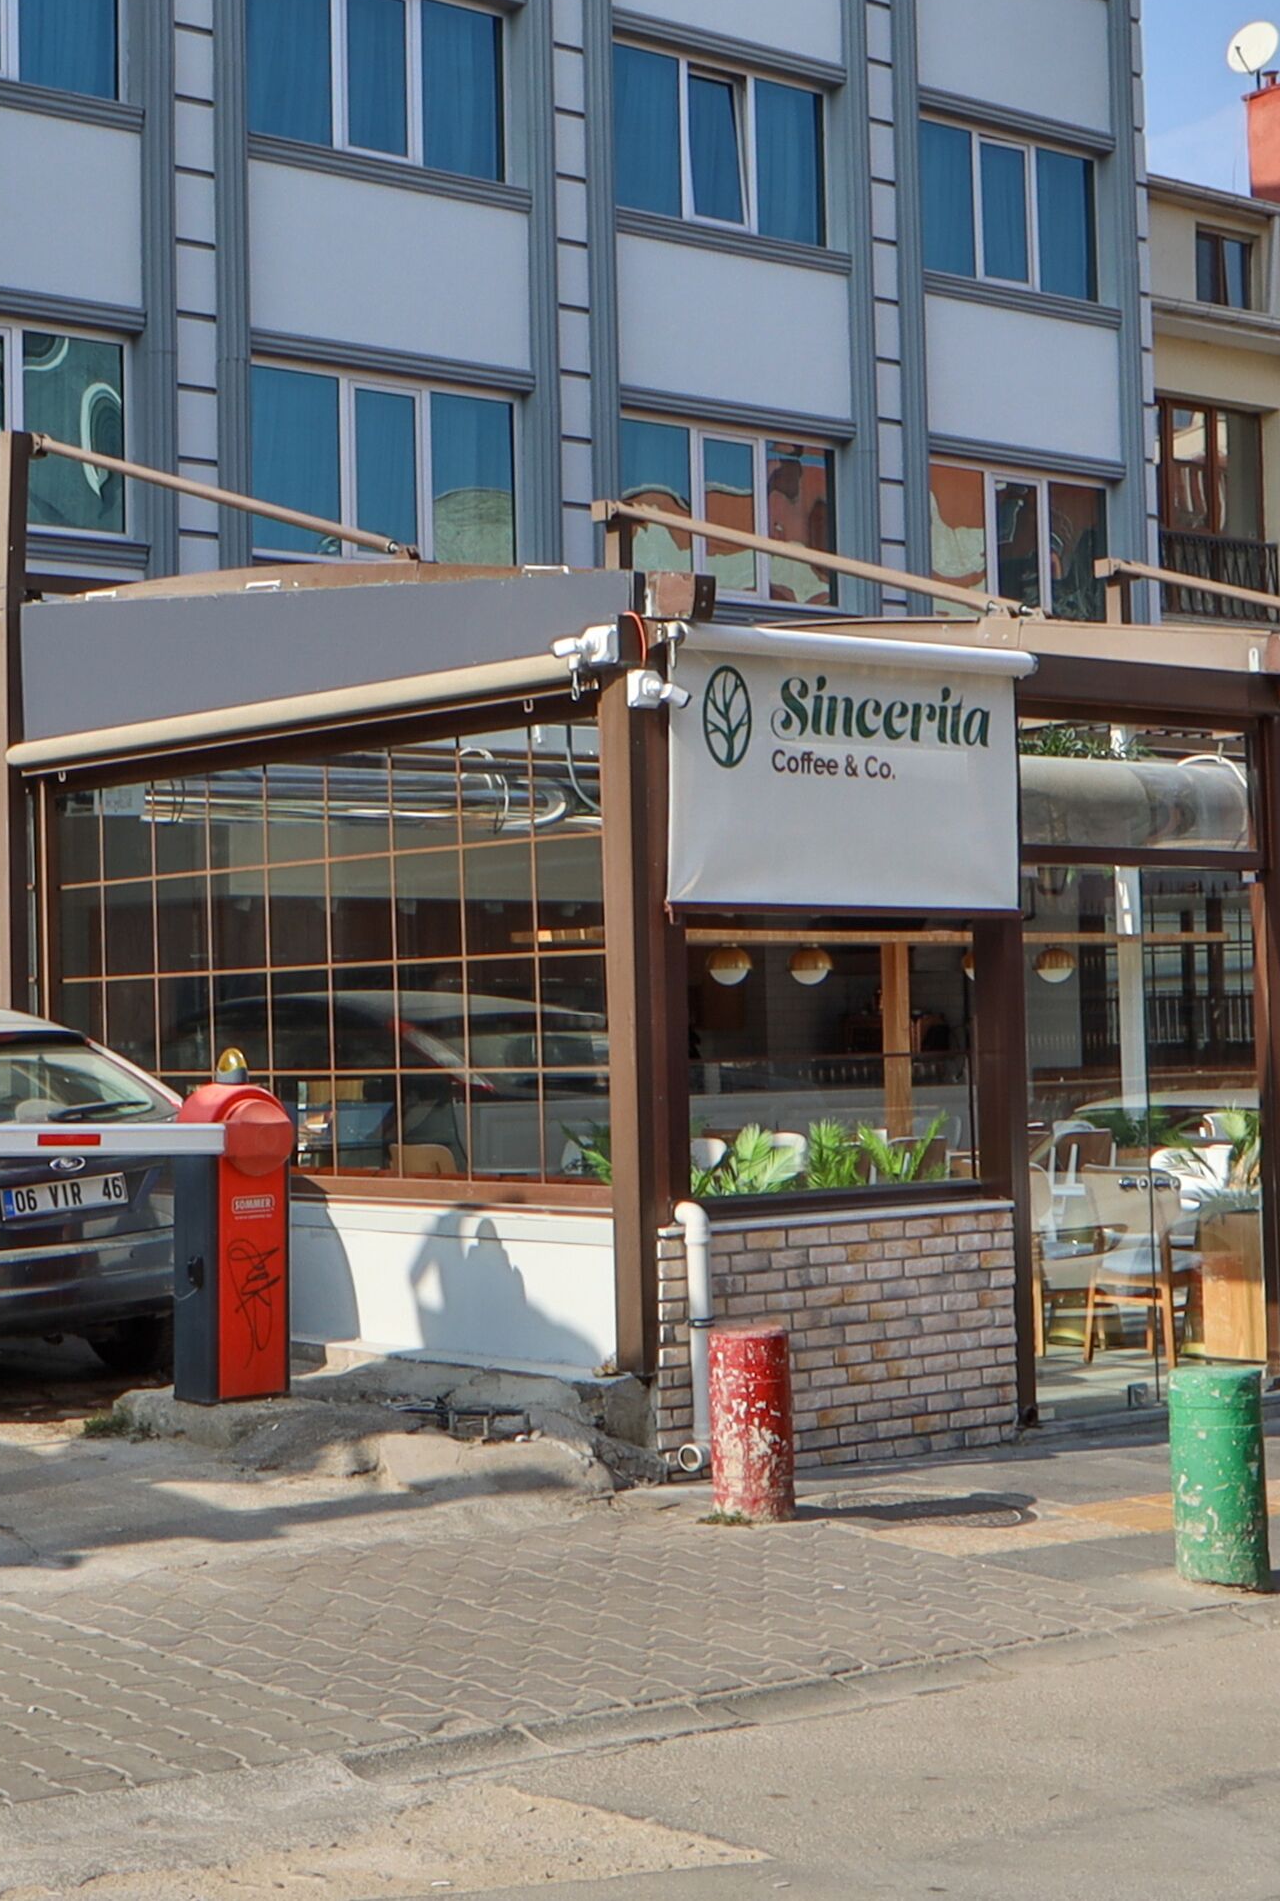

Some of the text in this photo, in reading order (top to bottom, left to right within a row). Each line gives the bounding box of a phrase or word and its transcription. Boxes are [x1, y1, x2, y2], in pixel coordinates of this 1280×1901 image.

[771, 675, 991, 748] Sincerita
[771, 749, 896, 780] Coffee & Co.
[15, 1176, 123, 1212] 06 VIR 46
[235, 1199, 271, 1211] SOMMER
